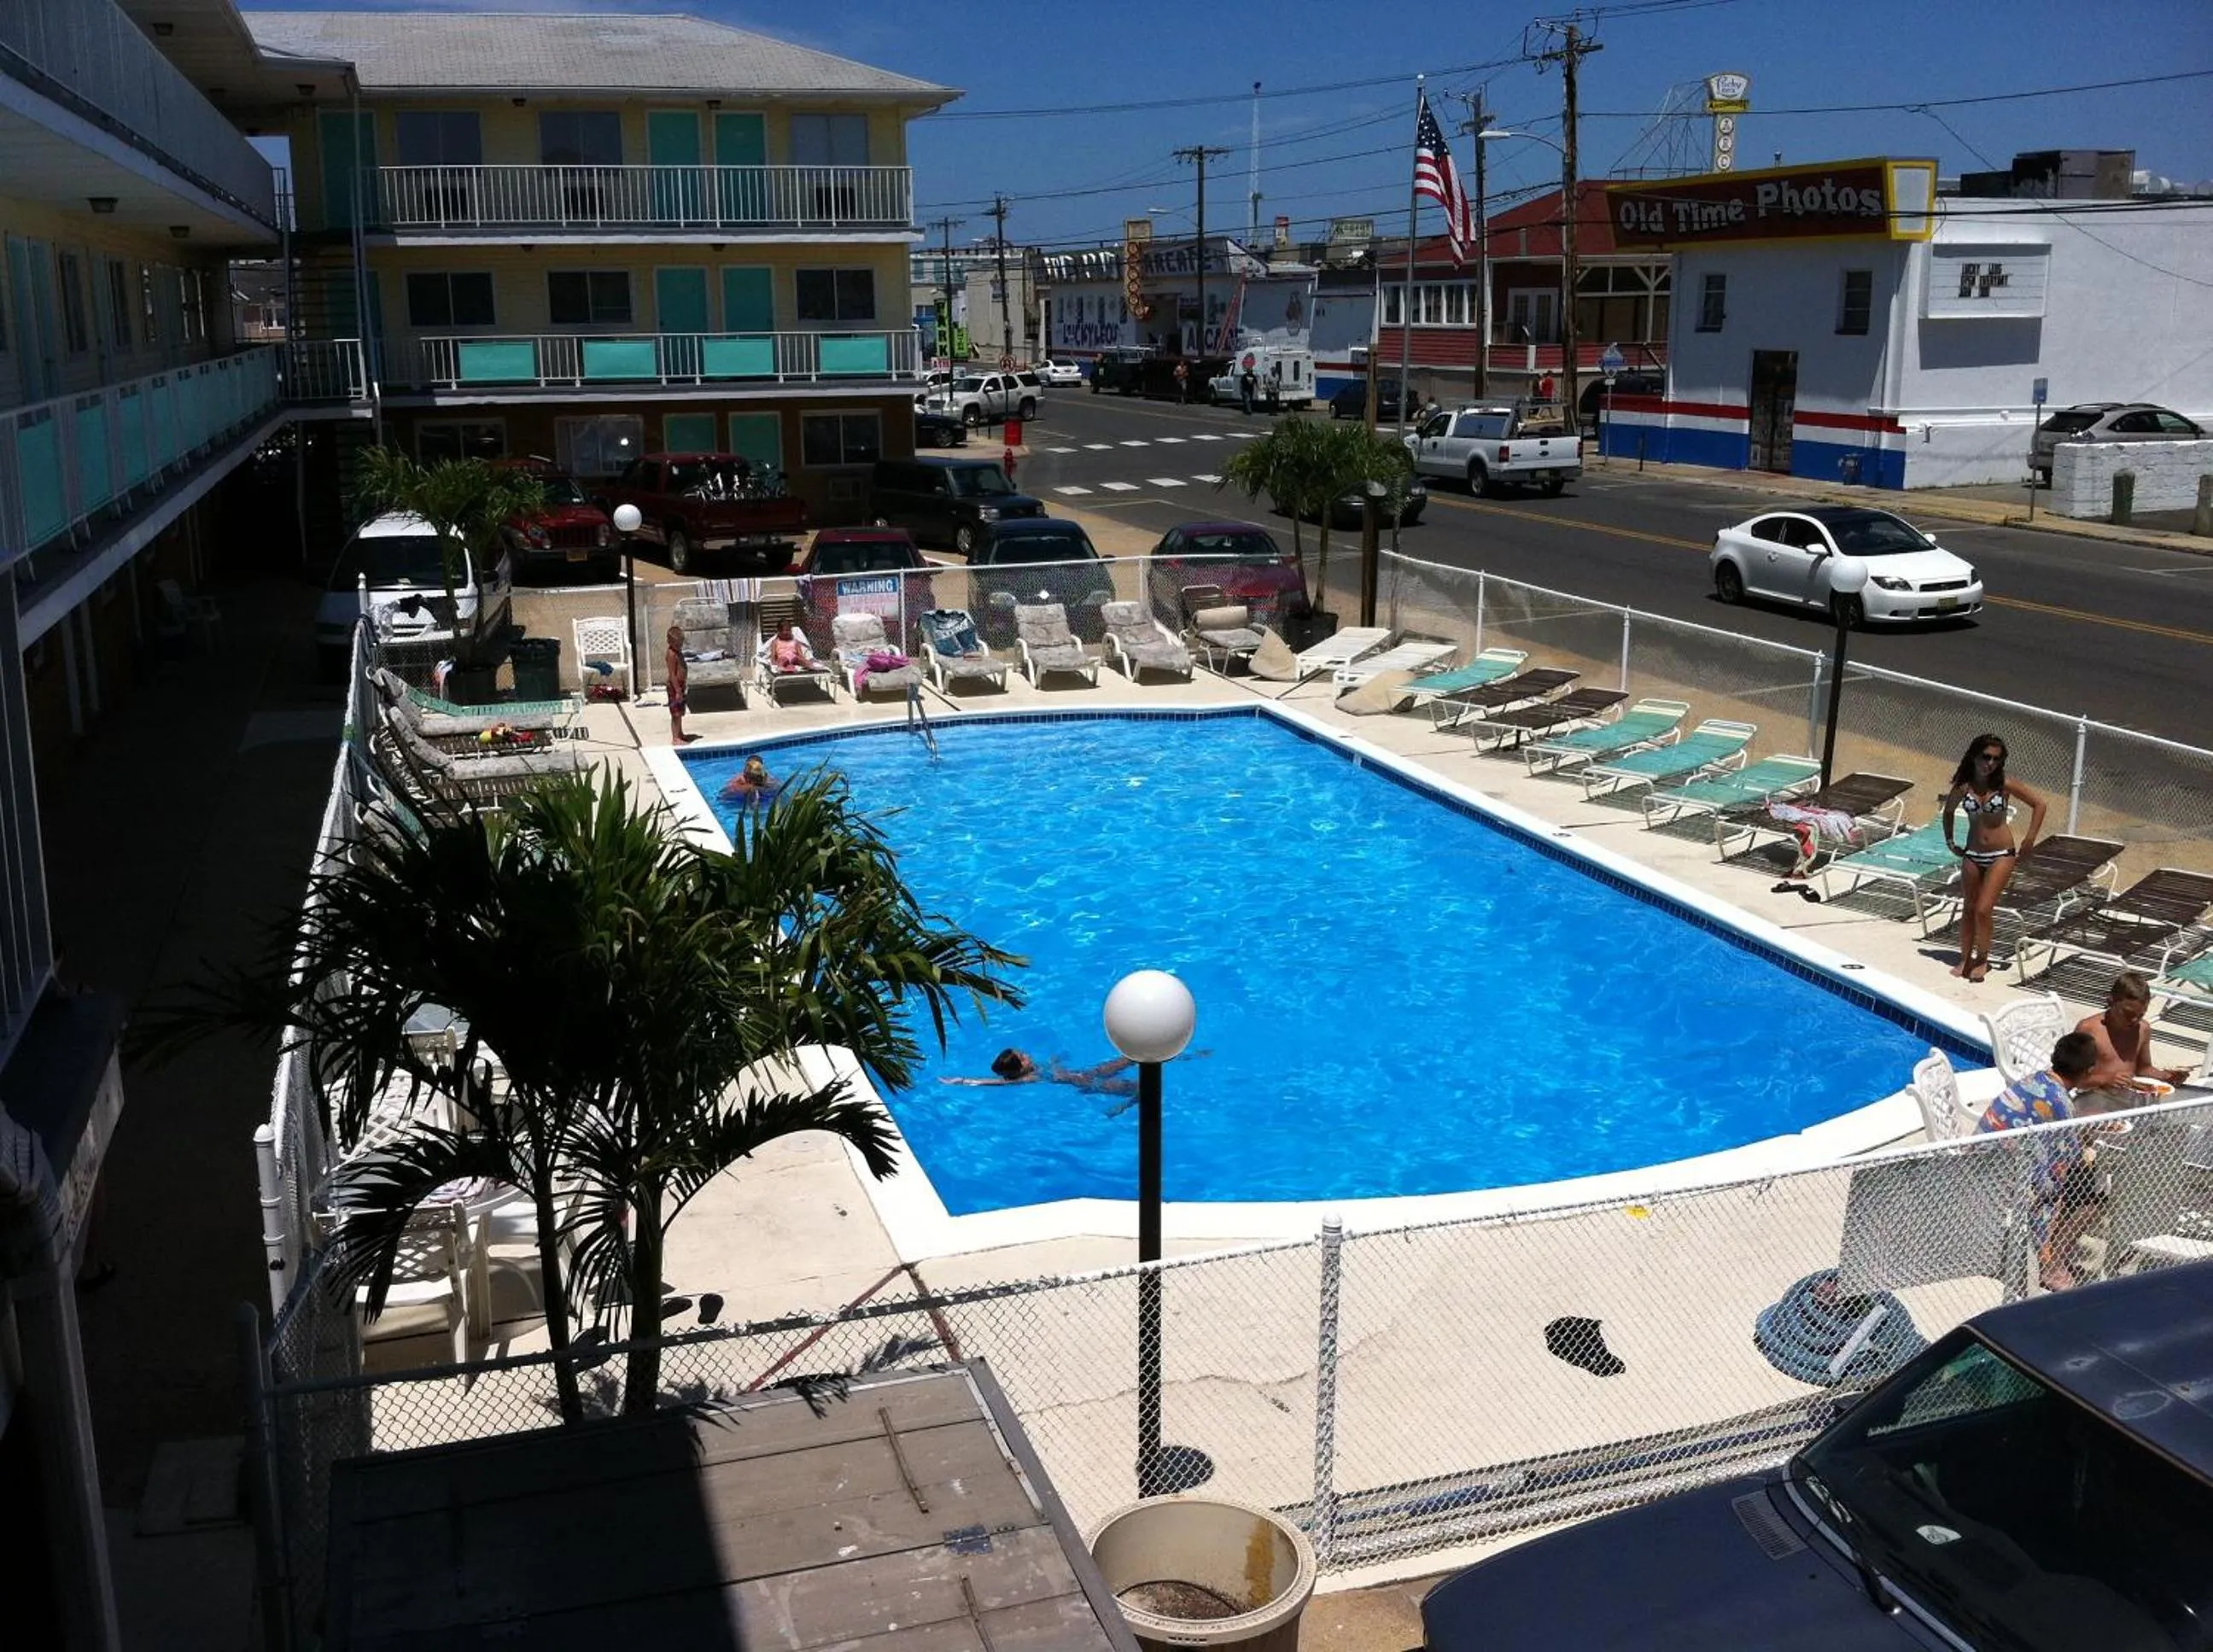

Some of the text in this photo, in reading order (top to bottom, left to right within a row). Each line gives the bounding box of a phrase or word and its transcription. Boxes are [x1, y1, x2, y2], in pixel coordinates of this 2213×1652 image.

[1620, 178, 1883, 233] Old Time Photos
[842, 579, 893, 595] WARNING
